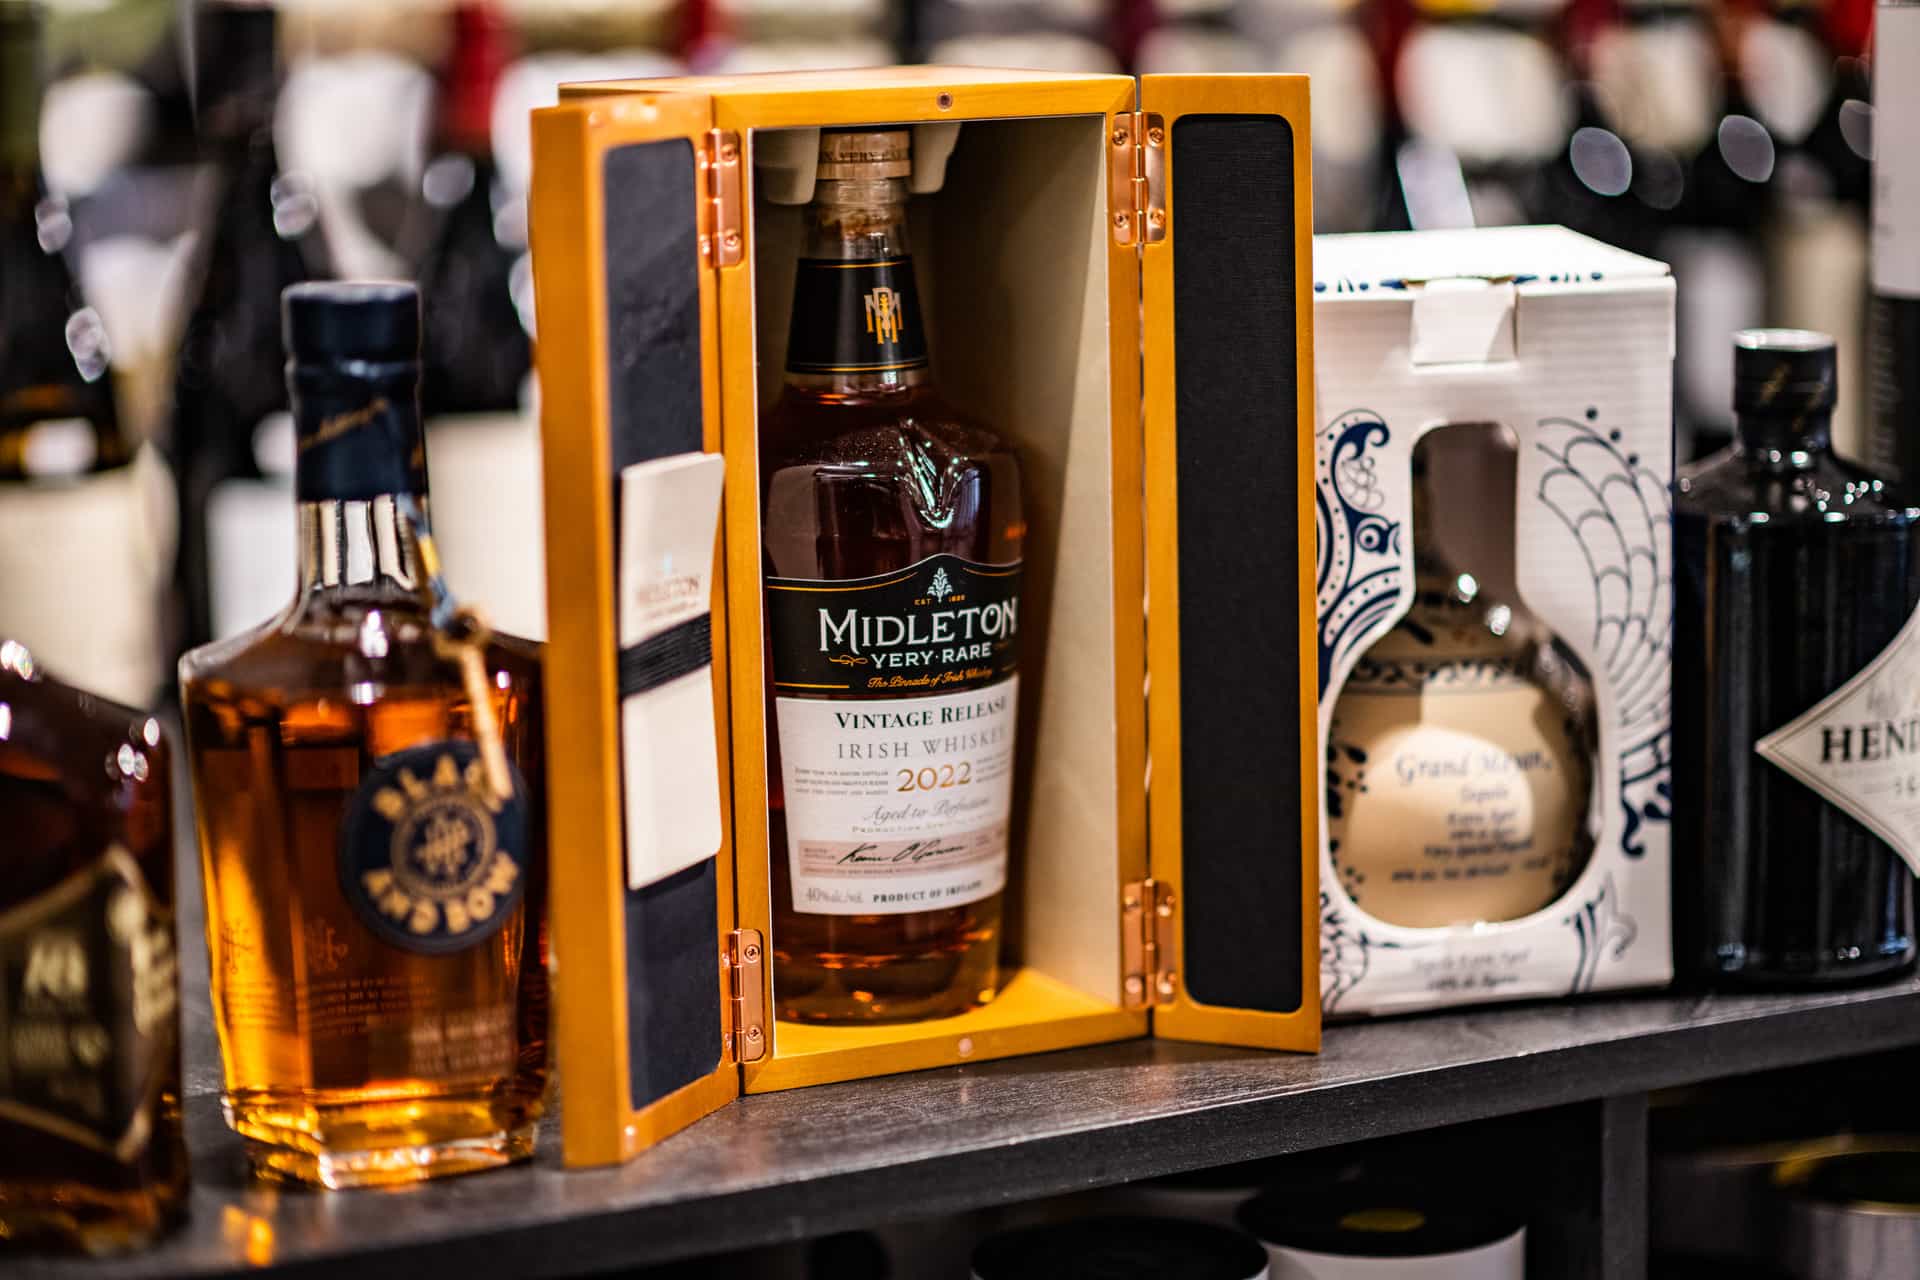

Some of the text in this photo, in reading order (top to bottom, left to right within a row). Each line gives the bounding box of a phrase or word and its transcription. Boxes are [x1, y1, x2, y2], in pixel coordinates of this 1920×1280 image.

[818, 596, 1018, 655] MIDLETON
[834, 711, 934, 729] VINTAGE
[838, 742, 909, 760] IRISH
[896, 760, 972, 792] 2022
[873, 890, 925, 903] PRODUCT
[929, 888, 941, 897] OF
